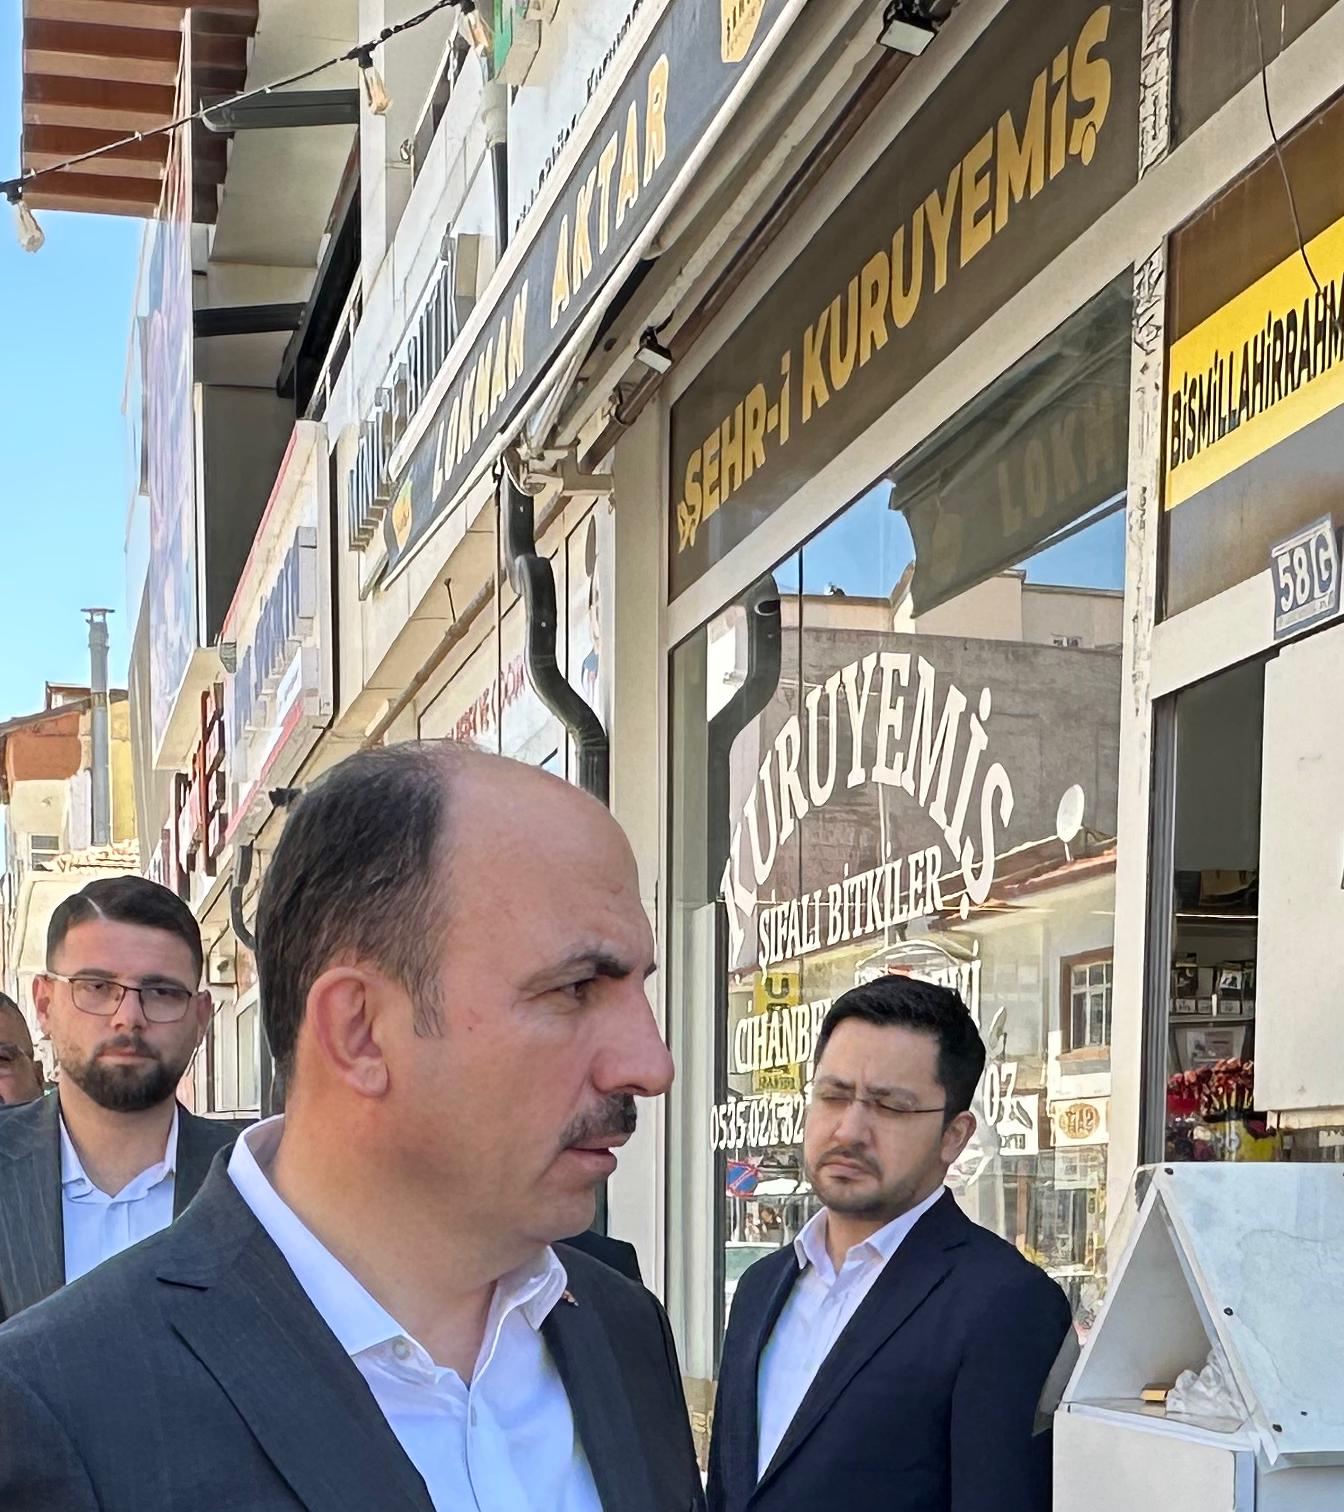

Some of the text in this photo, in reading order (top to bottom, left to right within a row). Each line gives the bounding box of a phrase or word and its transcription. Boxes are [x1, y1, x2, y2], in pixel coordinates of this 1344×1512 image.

[551, 53, 669, 328] AKTAR
[801, 5, 1112, 425] KURUYEMİŞ
[826, 842, 944, 946] BİTKİLER
